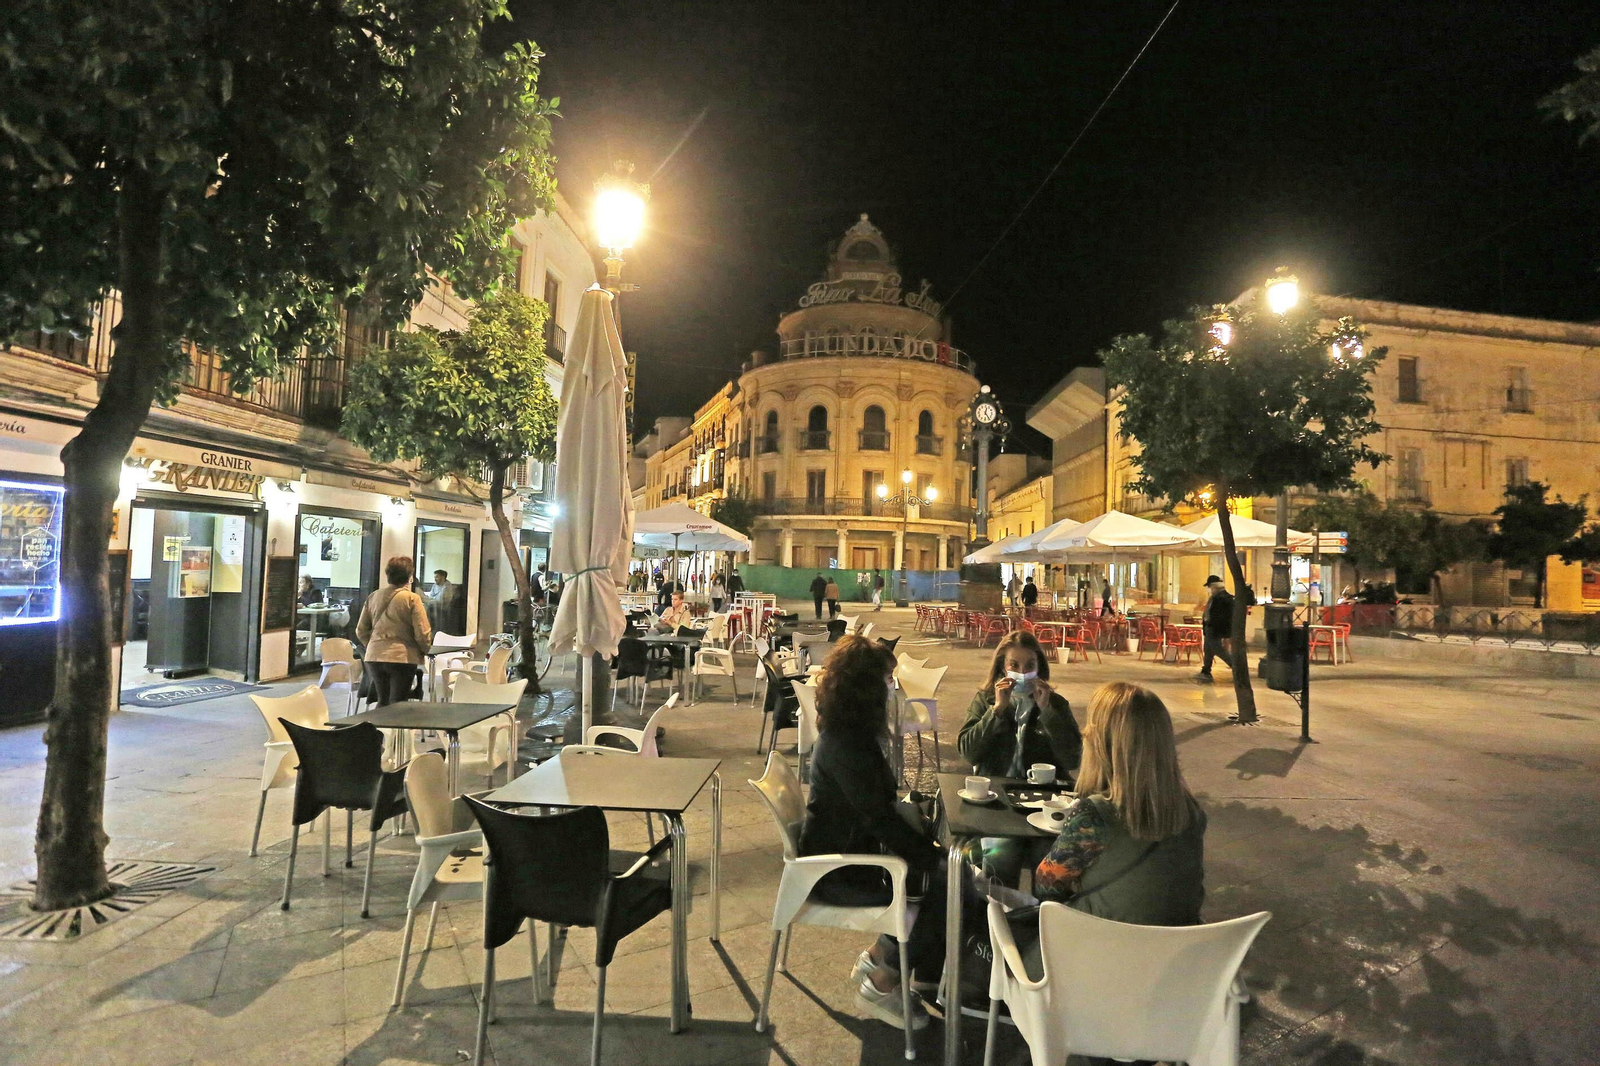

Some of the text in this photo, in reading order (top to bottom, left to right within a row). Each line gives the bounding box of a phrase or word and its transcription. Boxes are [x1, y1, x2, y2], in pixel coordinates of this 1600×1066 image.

[803, 330, 950, 364] FUNDADOR
[201, 452, 252, 471] GRANIER
[145, 457, 265, 500] GRANIER
[301, 515, 370, 537] Cafetería
